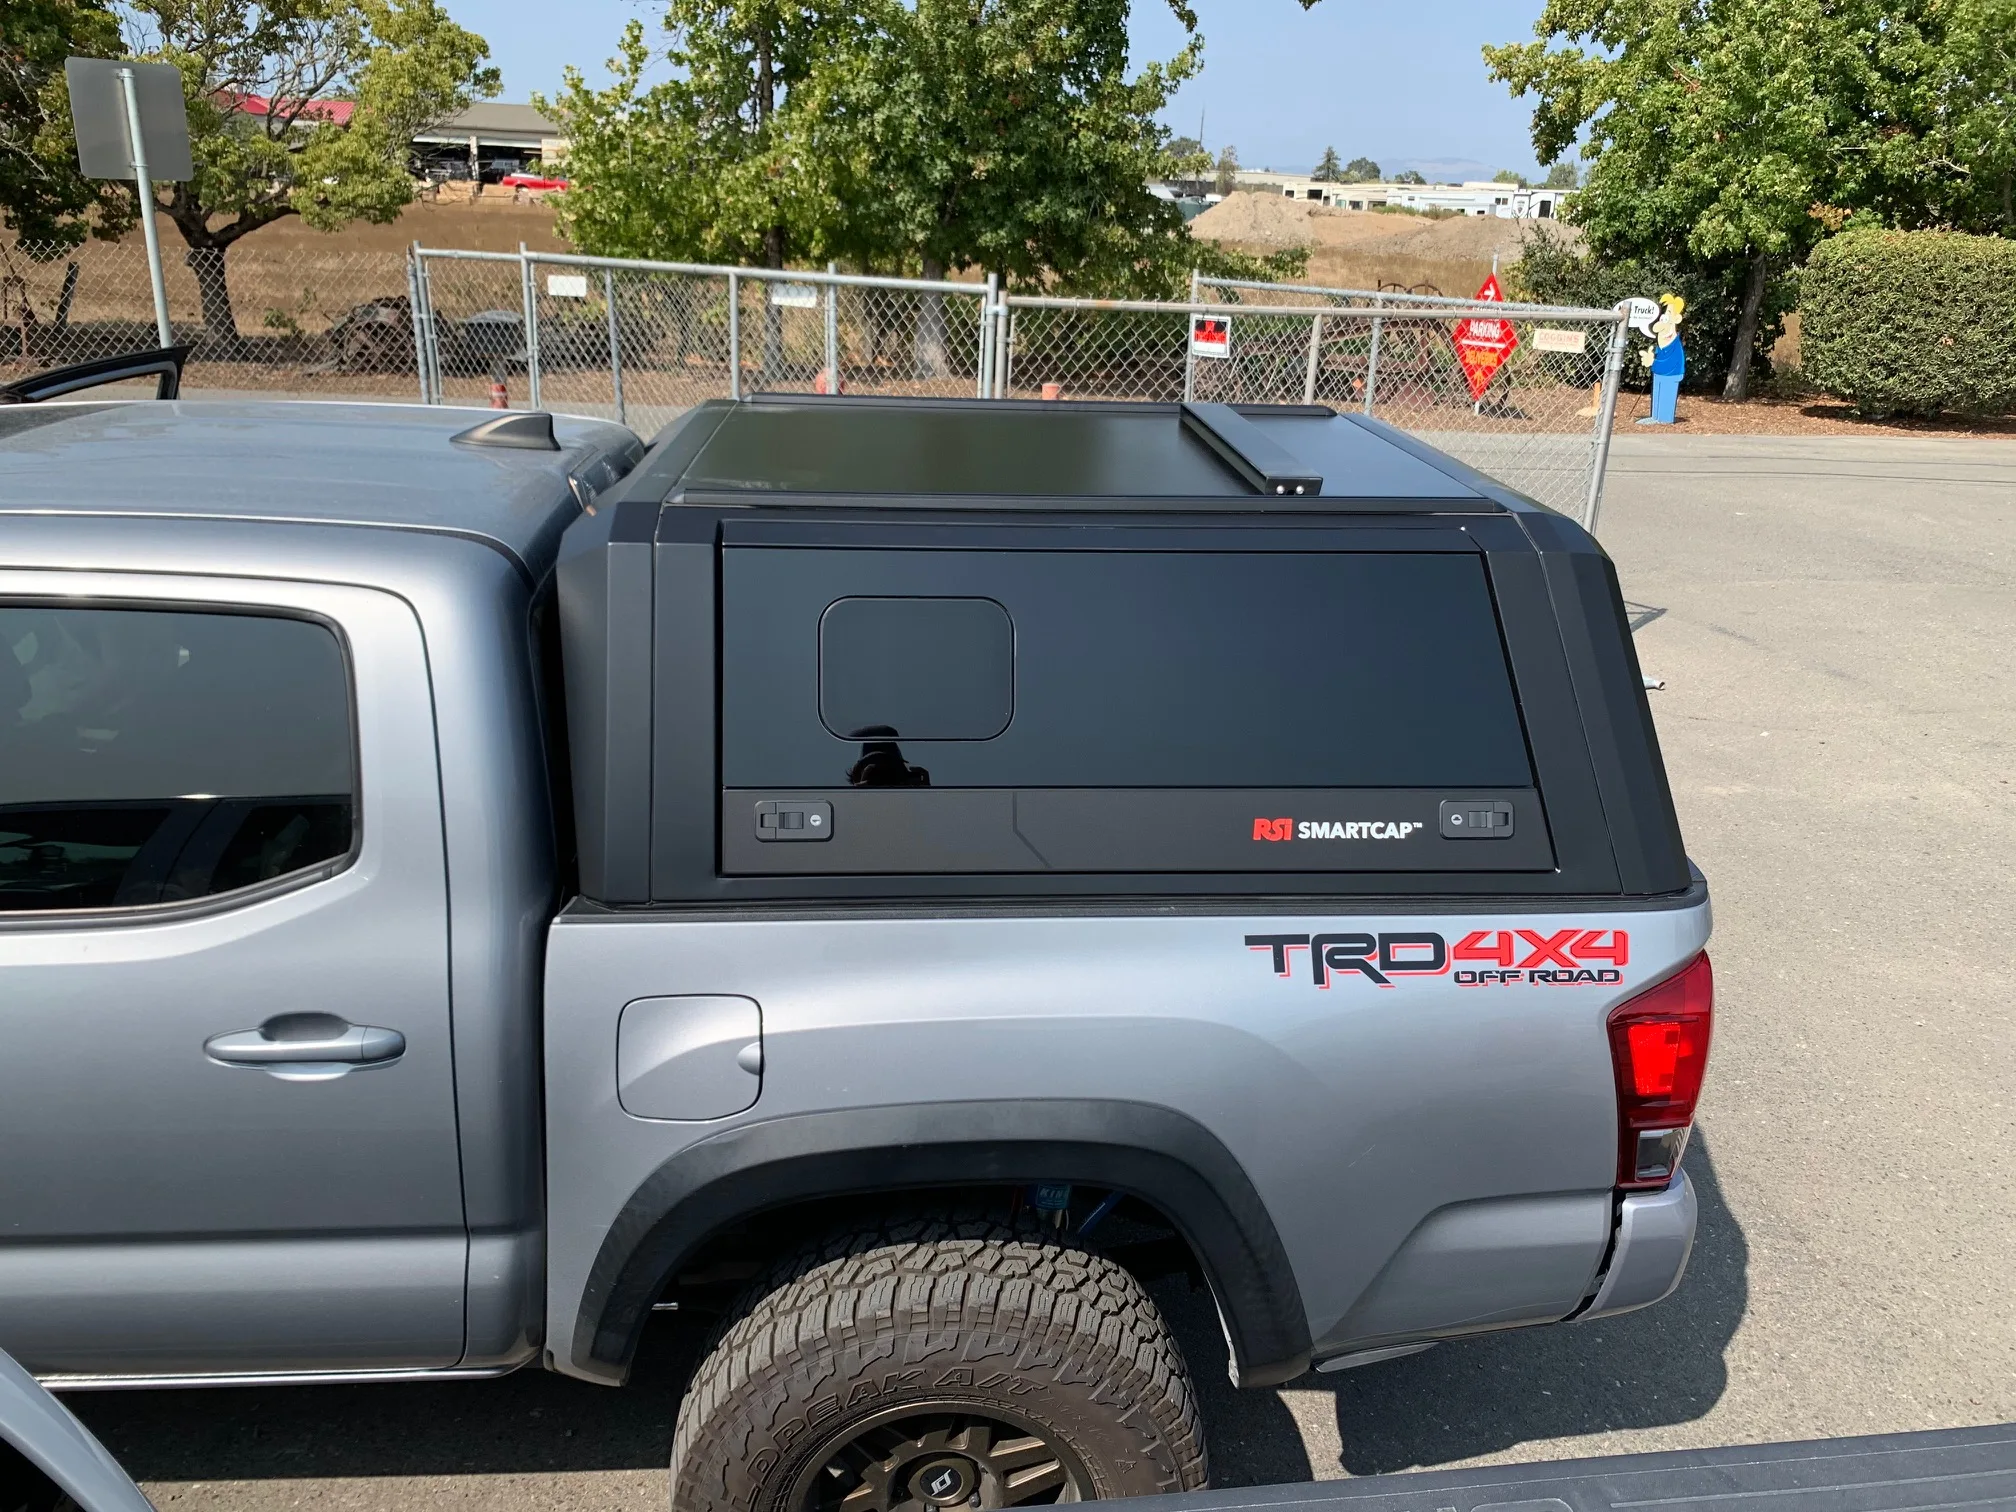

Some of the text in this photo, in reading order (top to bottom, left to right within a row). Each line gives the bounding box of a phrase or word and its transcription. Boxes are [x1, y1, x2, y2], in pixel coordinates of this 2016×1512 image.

[1634, 304, 1655, 315] Truck!
[1469, 319, 1501, 339] PARKING
[1244, 929, 1629, 989] TRD 4X4
[1453, 969, 1624, 987] OFF ROAD
